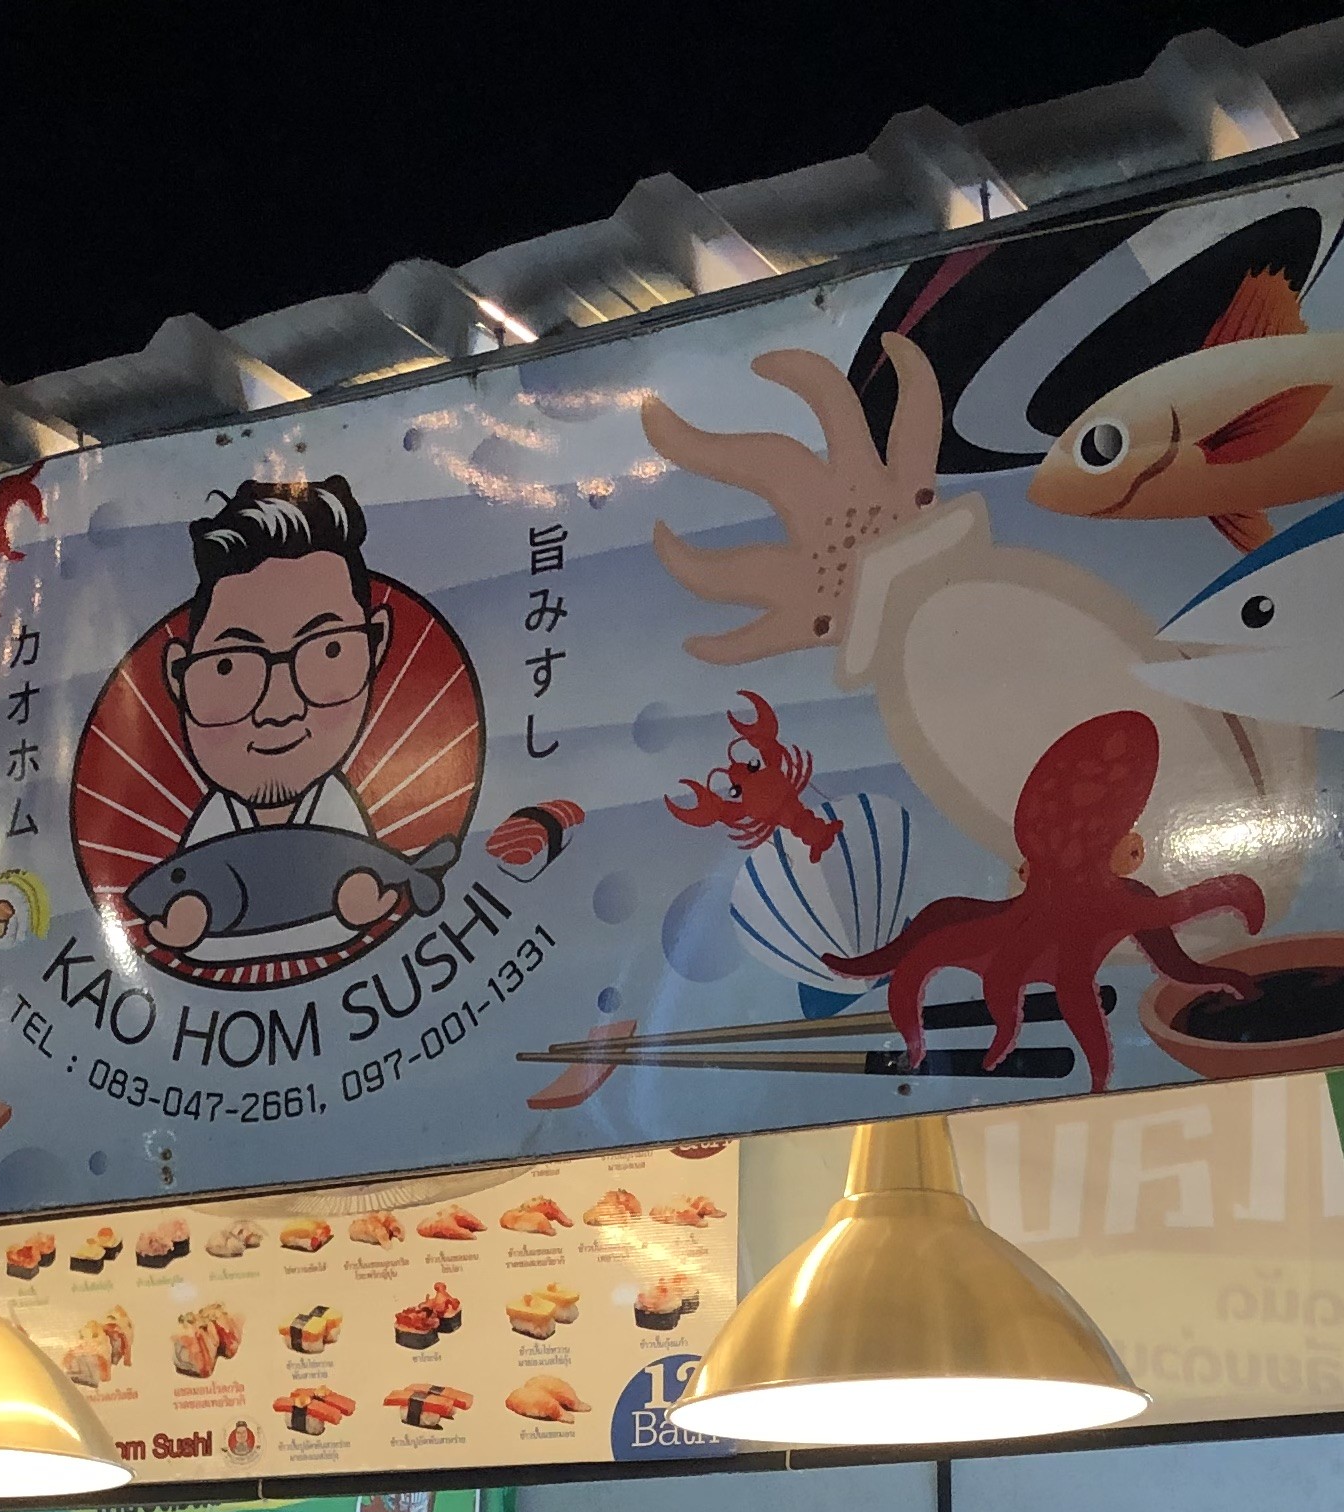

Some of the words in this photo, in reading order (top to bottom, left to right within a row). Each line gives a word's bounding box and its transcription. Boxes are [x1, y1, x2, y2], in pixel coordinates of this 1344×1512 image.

[5, 623, 40, 840] カオホム
[522, 523, 570, 760] 旨みすし
[9, 994, 57, 1061] TEL
[88, 1059, 326, 1123] 083-047-2661,
[342, 927, 559, 1104] 097-001-1331
[42, 938, 157, 1045] KAO
[174, 1001, 322, 1068] HOM
[342, 882, 511, 1041] SUSHI
[152, 1430, 213, 1460] Sushi
